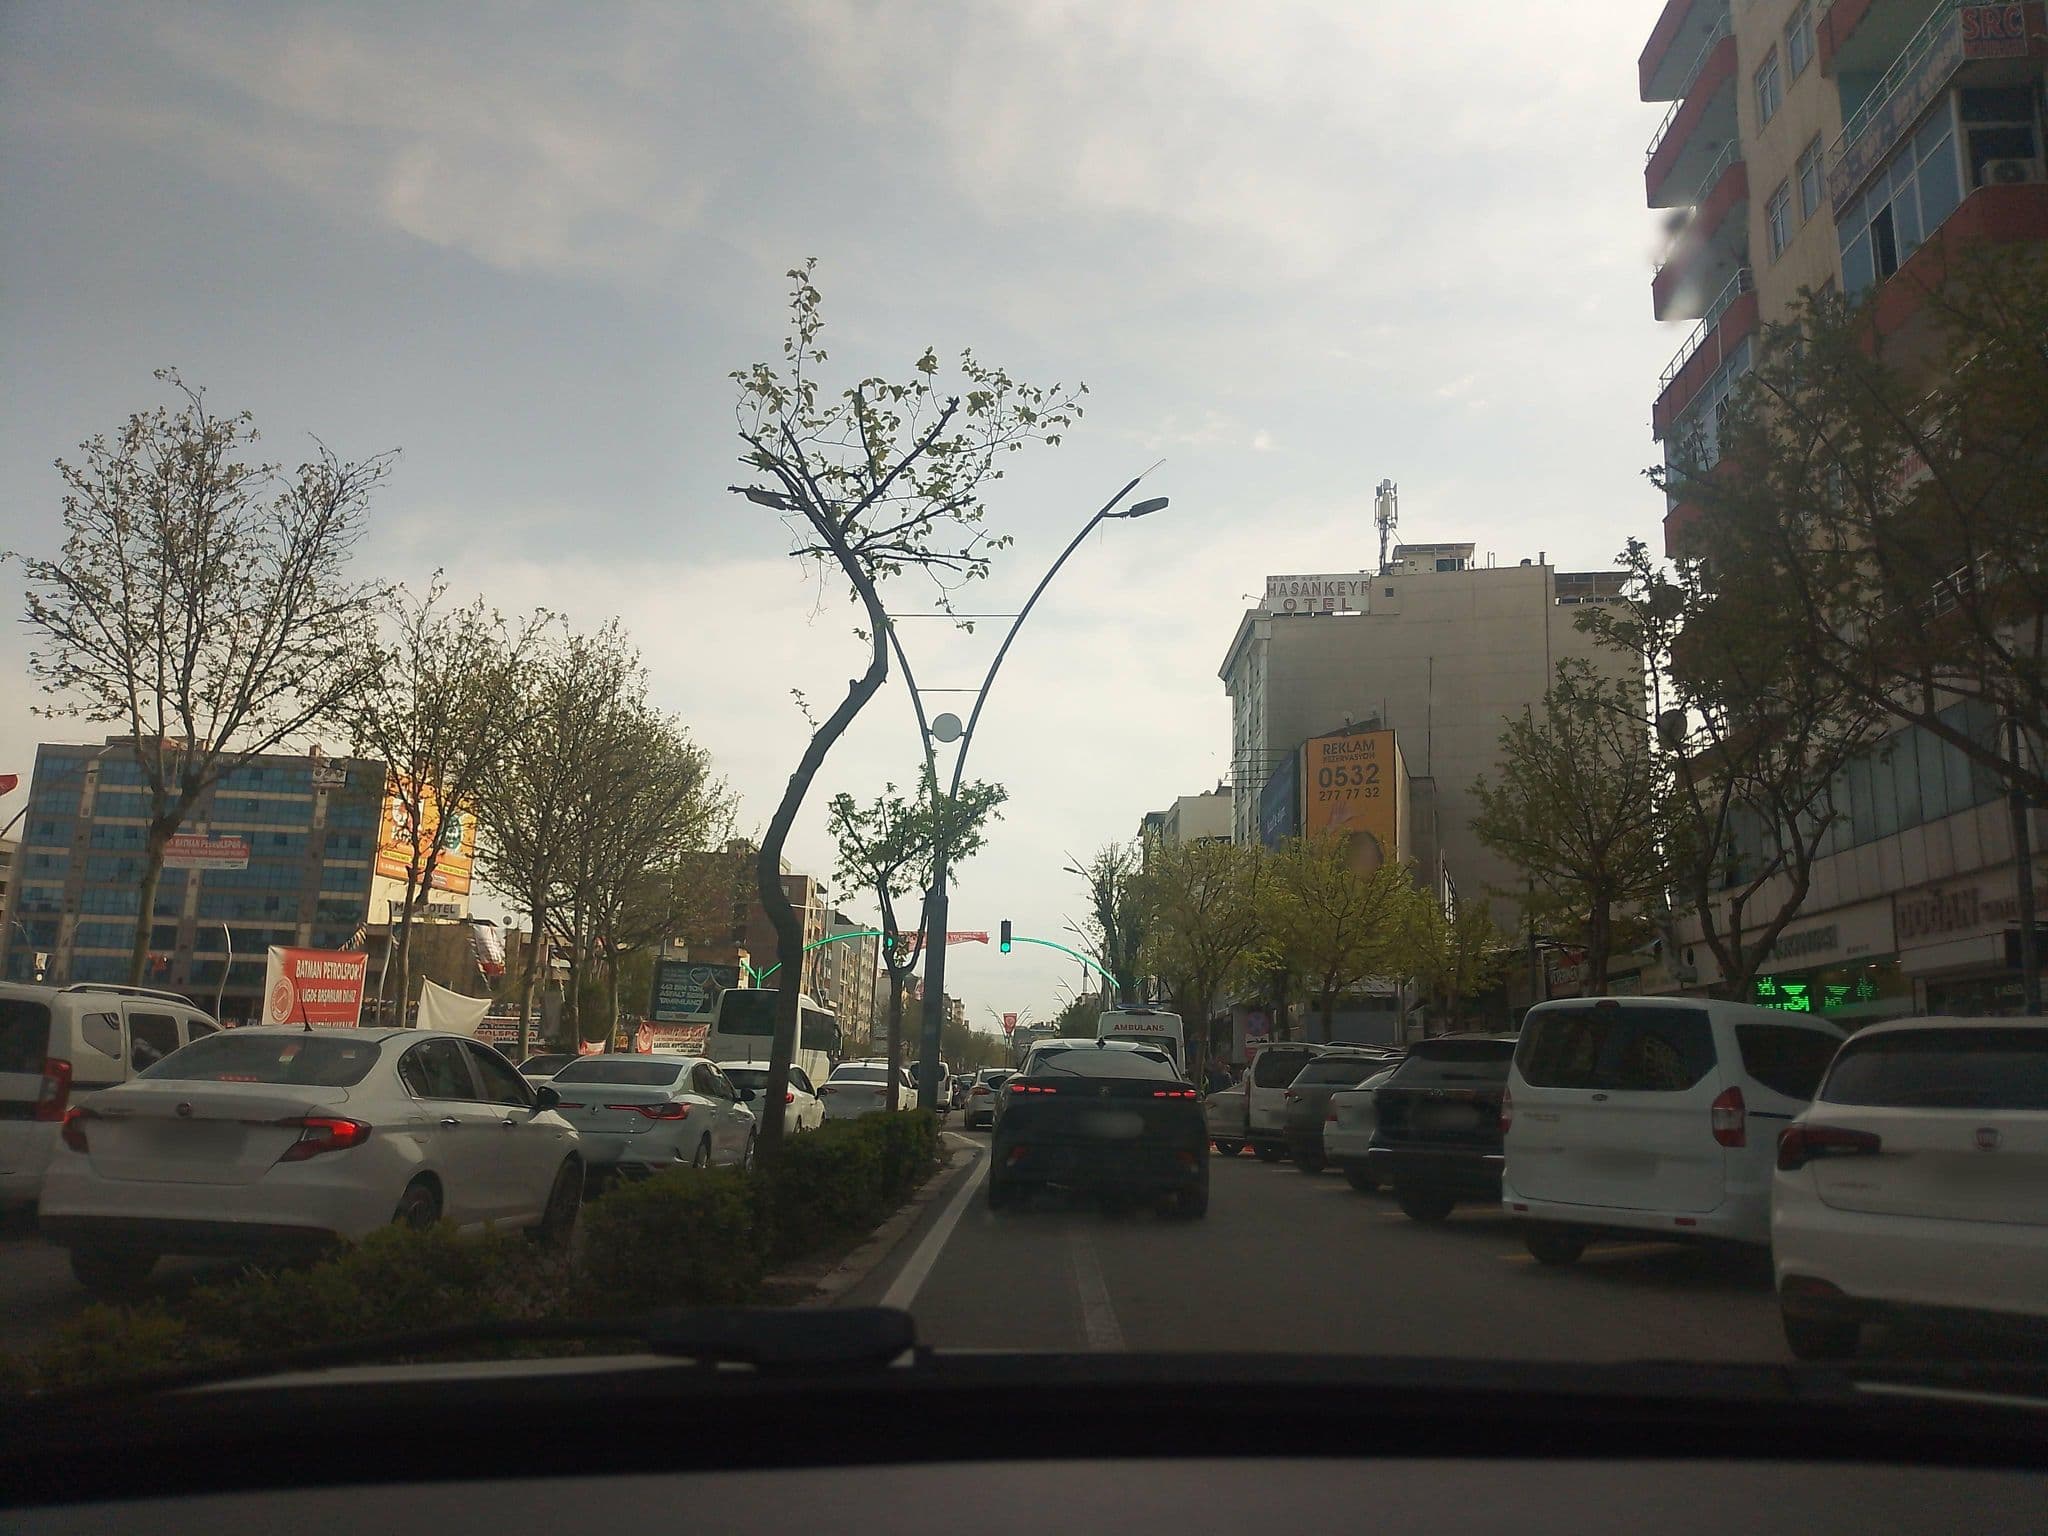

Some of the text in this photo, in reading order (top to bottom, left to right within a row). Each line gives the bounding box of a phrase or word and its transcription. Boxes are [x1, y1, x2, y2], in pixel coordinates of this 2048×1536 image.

[1961, 6, 2025, 40] SRC
[1267, 580, 1371, 598] HASANKEYF
[1283, 598, 1353, 612] OTEL
[1323, 740, 1375, 756] REKLAM
[1323, 752, 1375, 763] REZERVASYON
[1318, 763, 1380, 788] 0532
[1319, 786, 1380, 802] 277 77 32
[295, 959, 322, 979] BATMAN
[1113, 1023, 1165, 1032] AMBULANS
